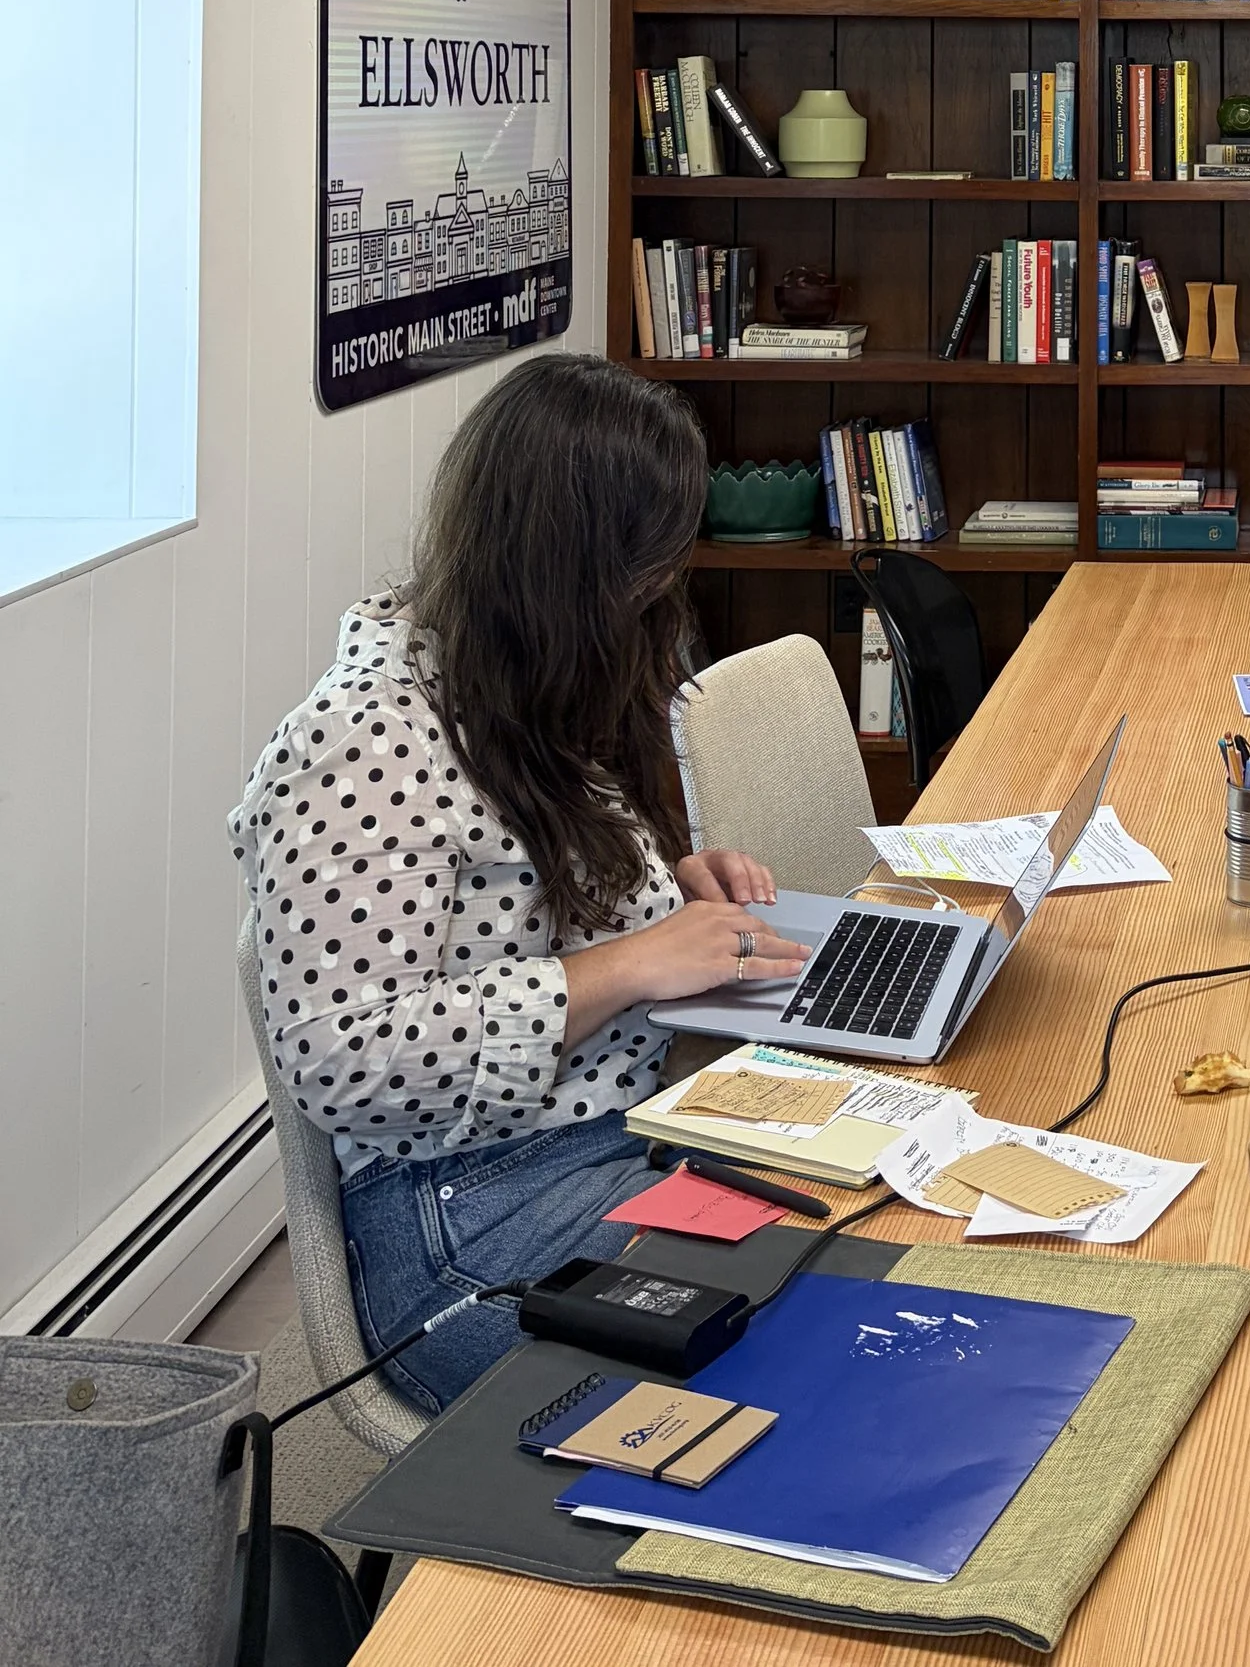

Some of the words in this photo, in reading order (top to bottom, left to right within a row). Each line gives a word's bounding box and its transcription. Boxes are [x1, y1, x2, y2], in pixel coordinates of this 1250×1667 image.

[358, 34, 551, 108] ELLSWORTH
[1115, 65, 1123, 104] DEMOCRACY
[652, 77, 663, 113] FREETHY
[658, 75, 670, 112] BARBARA
[690, 73, 701, 110] COLLEEN
[714, 88, 731, 109] HARLAN
[727, 107, 743, 124] COBEN
[739, 125, 751, 136] THE
[746, 136, 766, 159] INNOCENT
[1042, 110, 1052, 123] HIT
[660, 137, 668, 157] WORD
[664, 126, 673, 147] DON'T
[1138, 128, 1146, 150] Therapy
[1138, 151, 1146, 170] Family
[1023, 249, 1033, 280] Future
[1098, 247, 1108, 264] PROUD
[503, 277, 537, 330] mdf
[959, 284, 976, 316] INNOCENT
[1023, 281, 1033, 308] Youth
[1054, 293, 1063, 305] Don
[1064, 278, 1072, 335] UNDERWOR
[1098, 295, 1108, 321] ROSEMARY
[950, 317, 965, 339] BLOOD
[1054, 308, 1063, 333] DeLillo
[331, 326, 403, 378] HISTORIC
[407, 309, 445, 357] MAIN
[447, 301, 492, 346] STREET
[888, 463, 901, 500] Elizabeth
[894, 500, 904, 525] Strout
